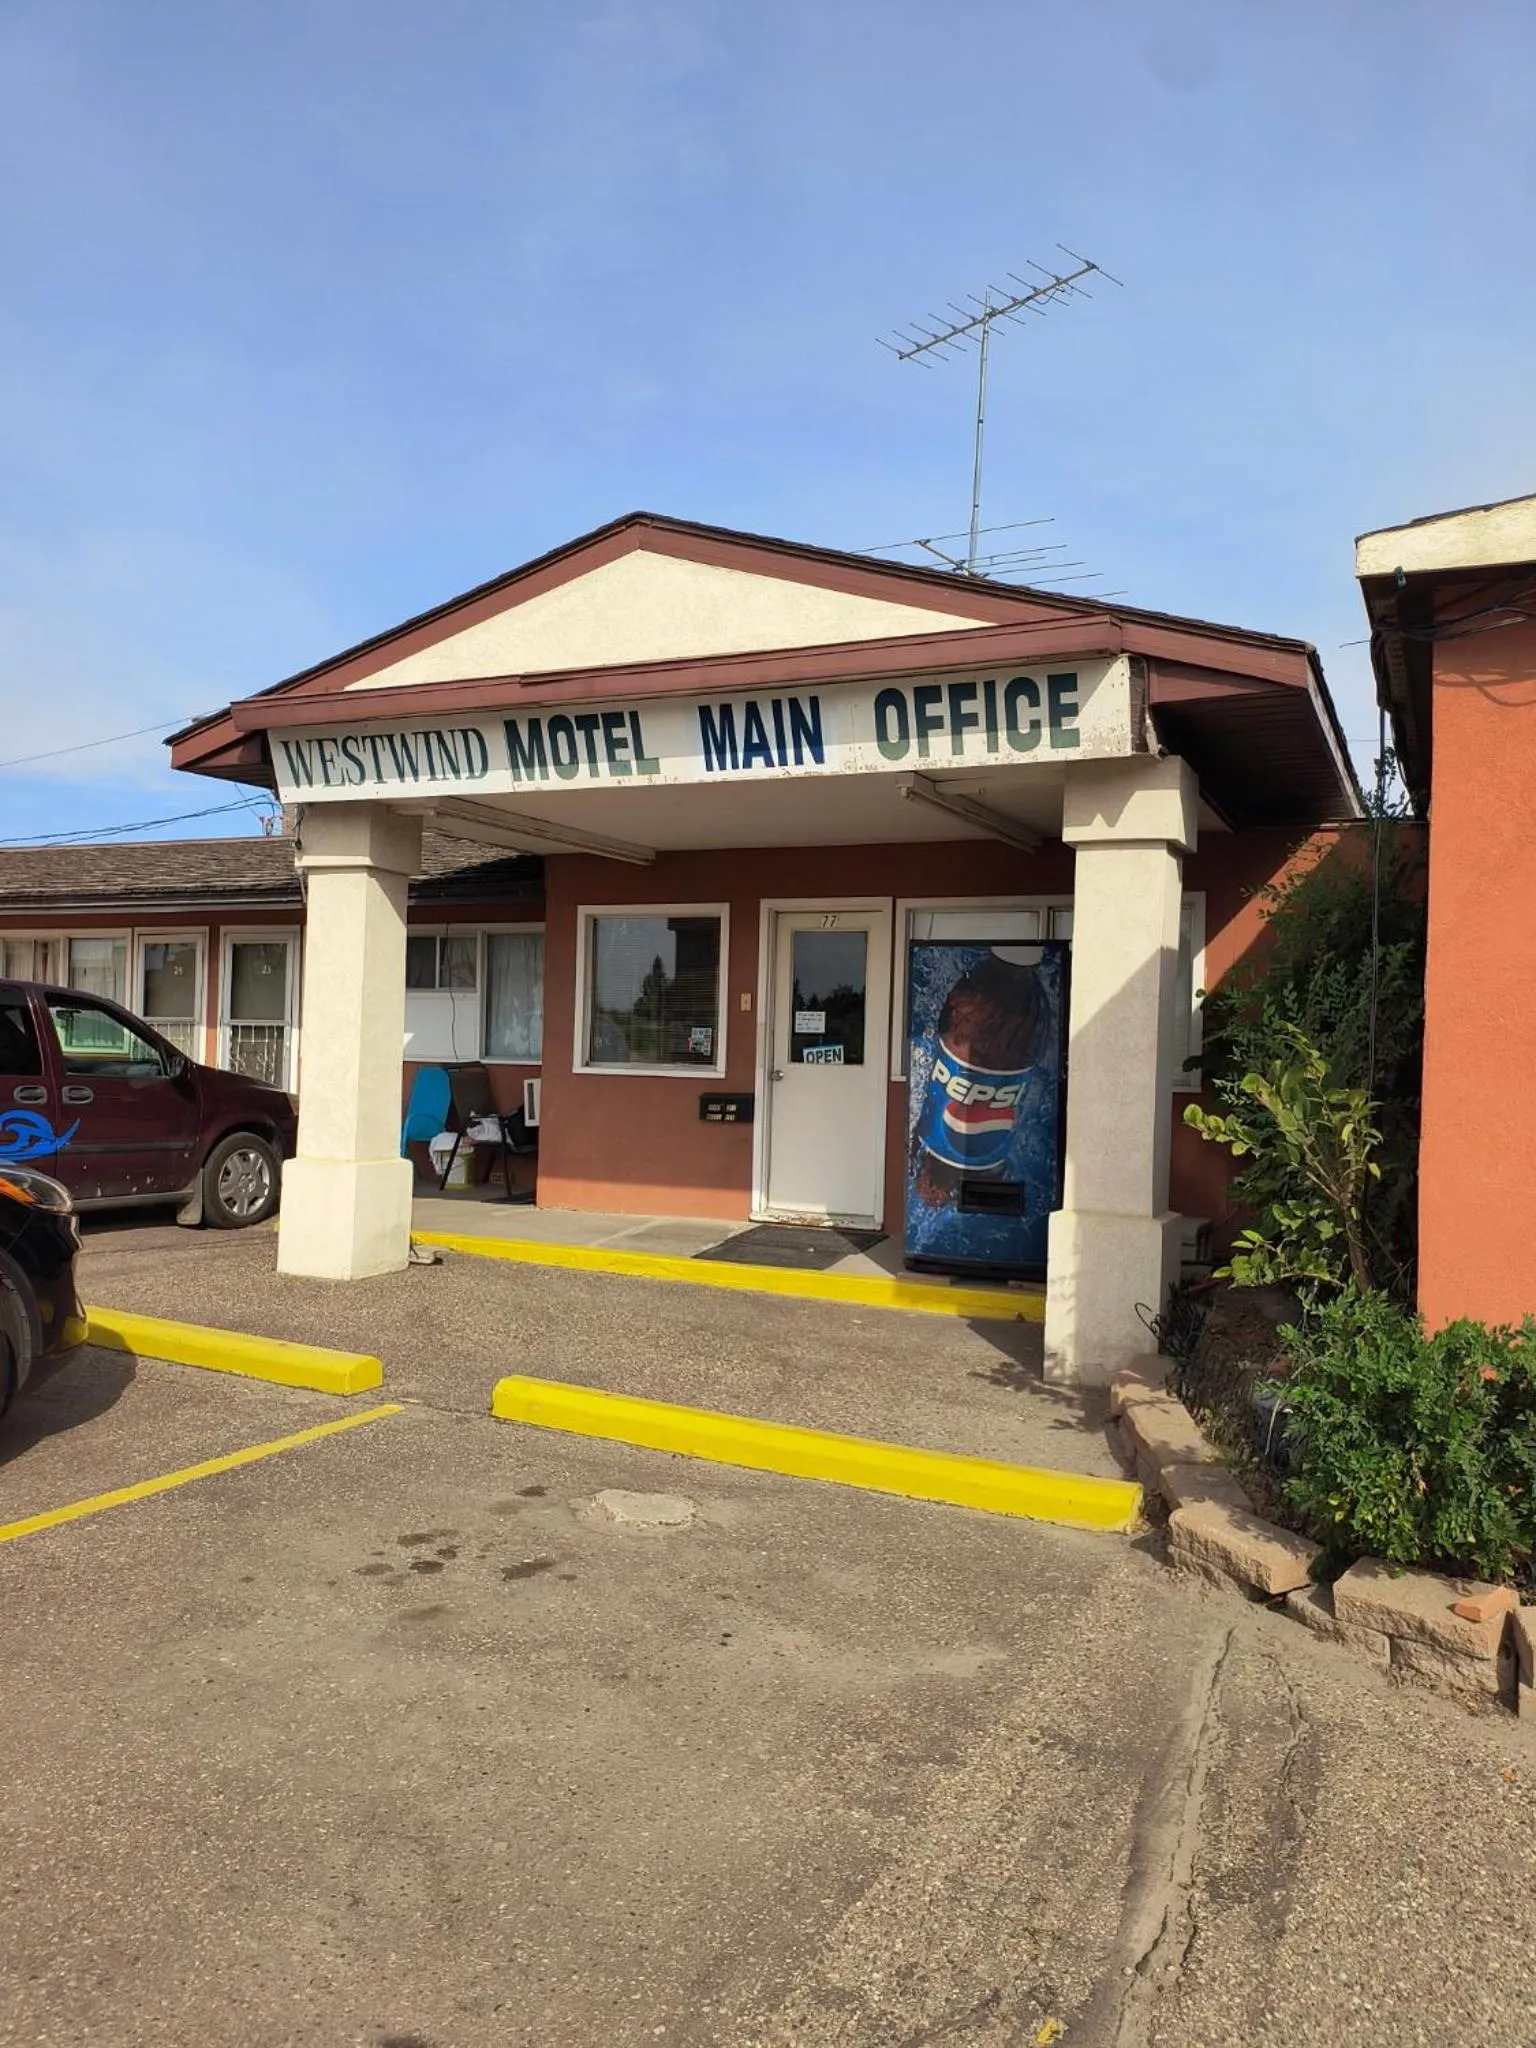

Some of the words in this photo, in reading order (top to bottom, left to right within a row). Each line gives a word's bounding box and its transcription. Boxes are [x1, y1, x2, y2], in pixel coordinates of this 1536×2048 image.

[280, 727, 488, 789] WESTWIND
[503, 710, 661, 782] MOTEL
[698, 695, 825, 772] MAIN
[874, 672, 1080, 761] OFFICE
[822, 915, 837, 928] 77
[806, 1047, 842, 1064] OPEN
[931, 1058, 1027, 1109] PEPSI
